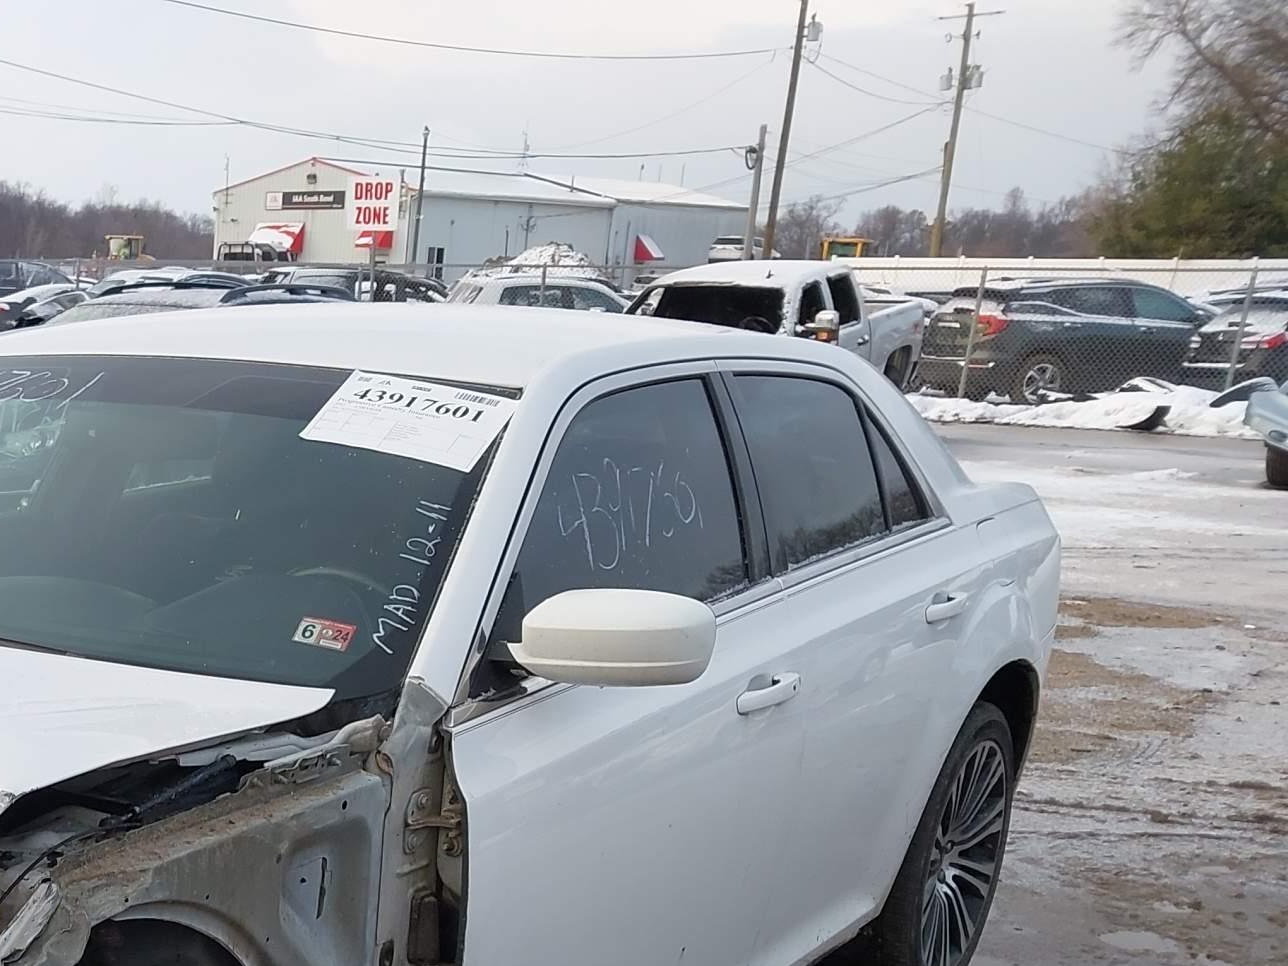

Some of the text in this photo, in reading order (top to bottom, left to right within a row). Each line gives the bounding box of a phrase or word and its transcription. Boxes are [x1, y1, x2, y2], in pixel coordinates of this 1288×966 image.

[355, 182, 393, 201] DROP
[355, 207, 390, 225] ZONE
[353, 388, 485, 423] 43917601
[371, 583, 421, 655] MAD
[301, 623, 317, 640] 6
